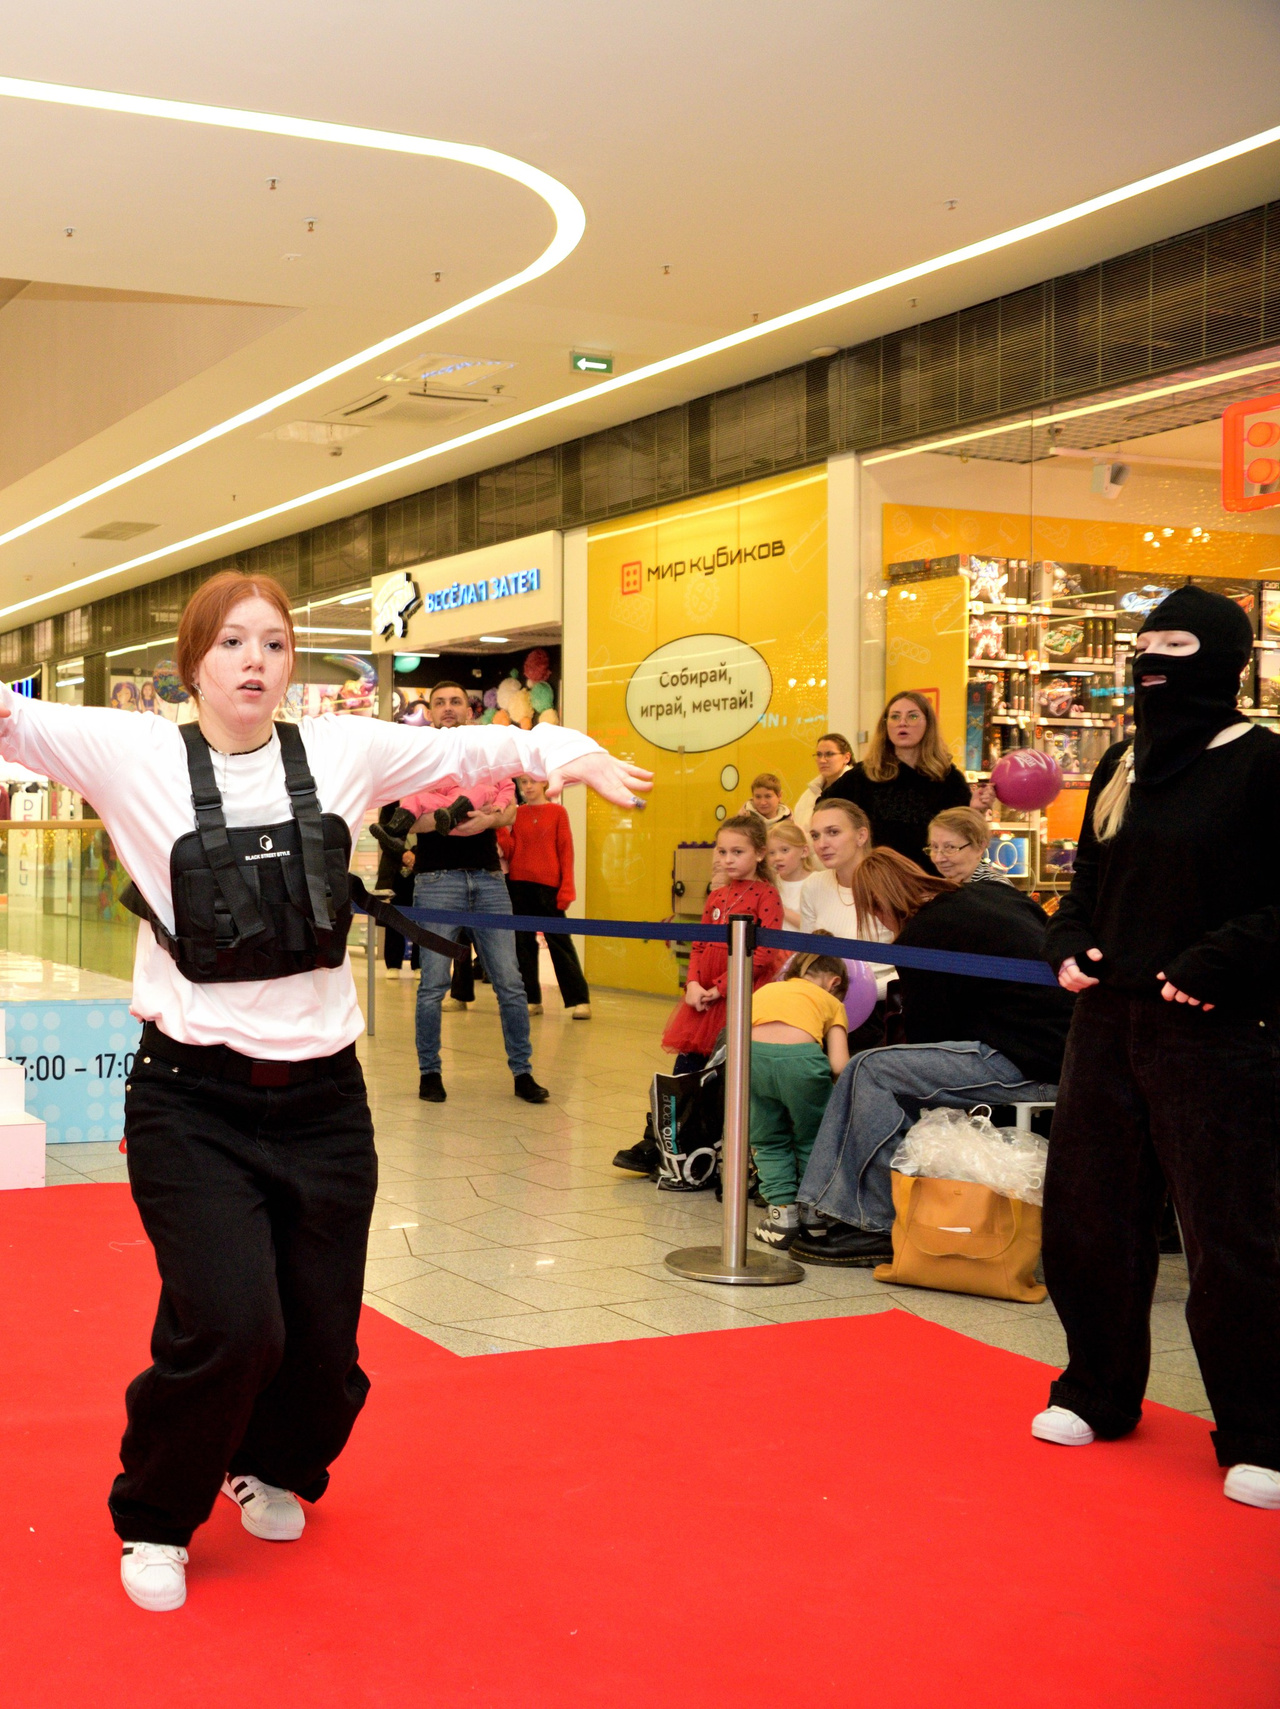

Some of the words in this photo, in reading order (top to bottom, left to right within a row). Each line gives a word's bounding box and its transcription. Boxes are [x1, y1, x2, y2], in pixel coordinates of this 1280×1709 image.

[689, 540, 785, 576] кубиков
[424, 580, 488, 614] ВЕСЁЛАЯ
[489, 567, 541, 600] ЗАТЕЯ
[659, 661, 732, 688] Собирай,
[640, 695, 687, 721] играй,
[691, 689, 754, 714] мечтай!
